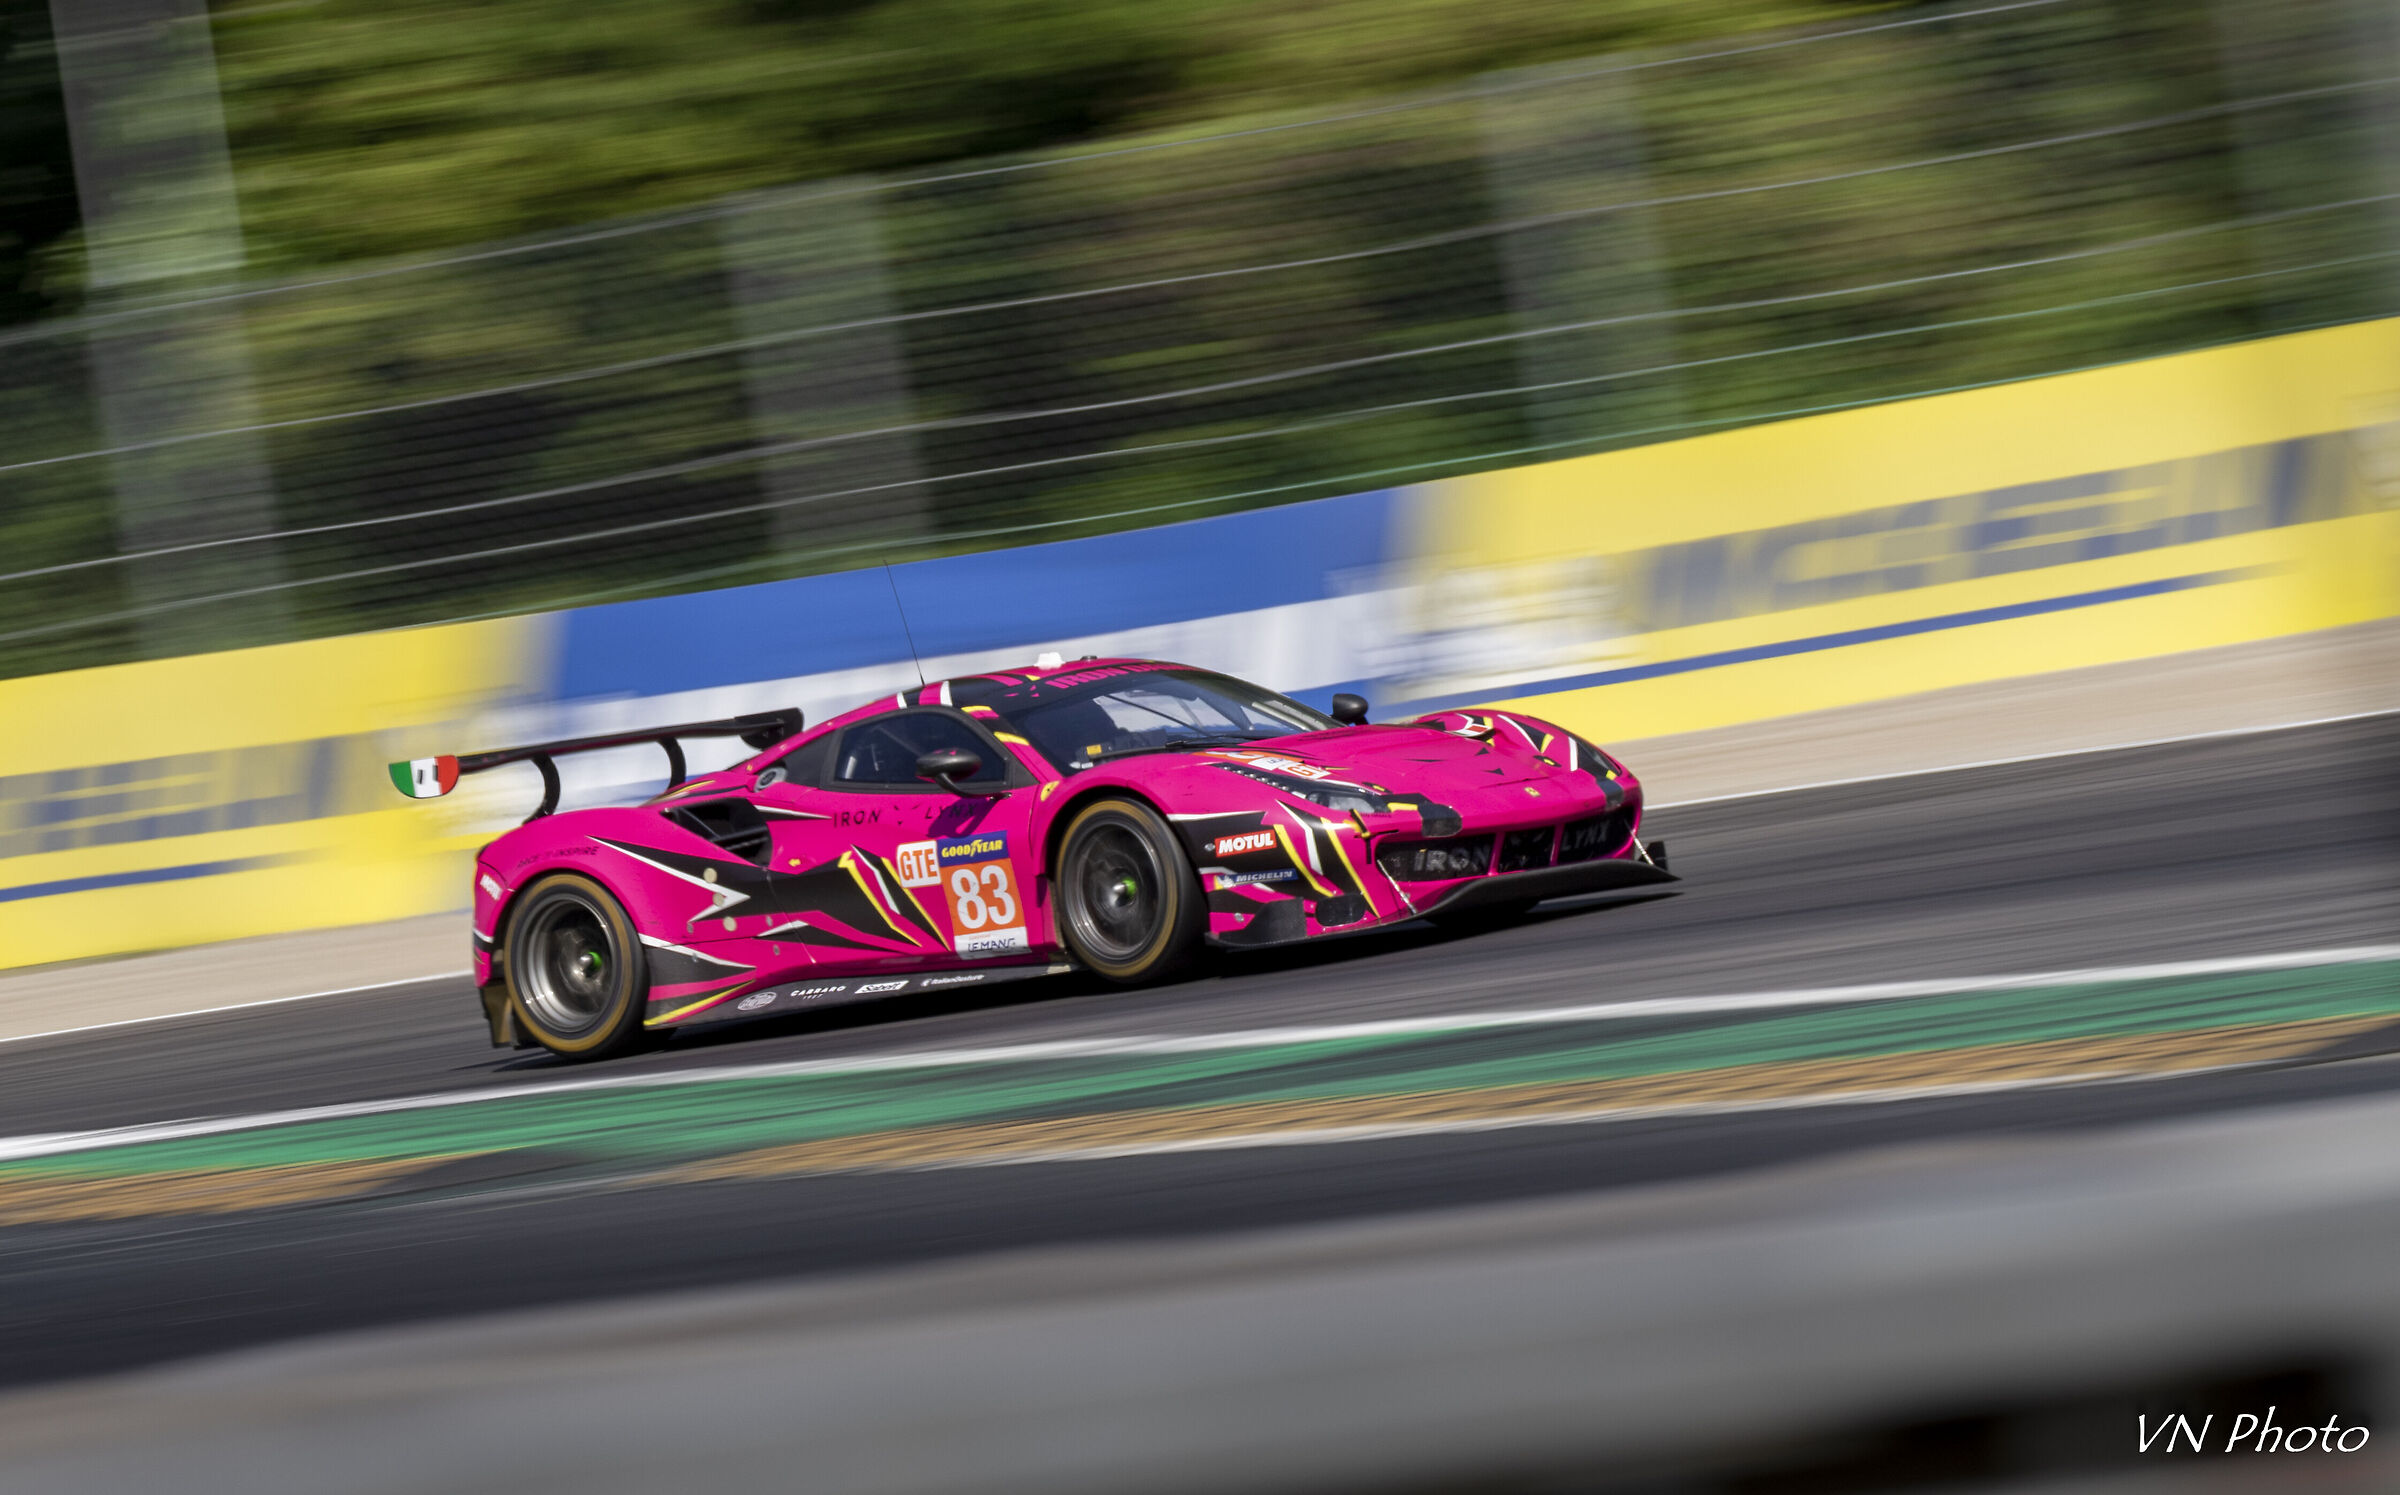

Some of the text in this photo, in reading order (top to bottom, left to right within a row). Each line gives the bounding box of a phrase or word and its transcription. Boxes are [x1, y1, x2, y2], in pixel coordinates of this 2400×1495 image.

[1045, 667, 1129, 689] IRON
[833, 803, 976, 828] IRON LYNX
[941, 838, 1004, 858] GOODYEAR
[1218, 832, 1274, 854] MOTUL
[1413, 819, 1611, 872] IRON LYNX
[900, 848, 937, 881] GTE
[1236, 871, 1293, 882] MICHELIN
[951, 865, 1016, 929] 83
[790, 985, 847, 997] CARRARO
